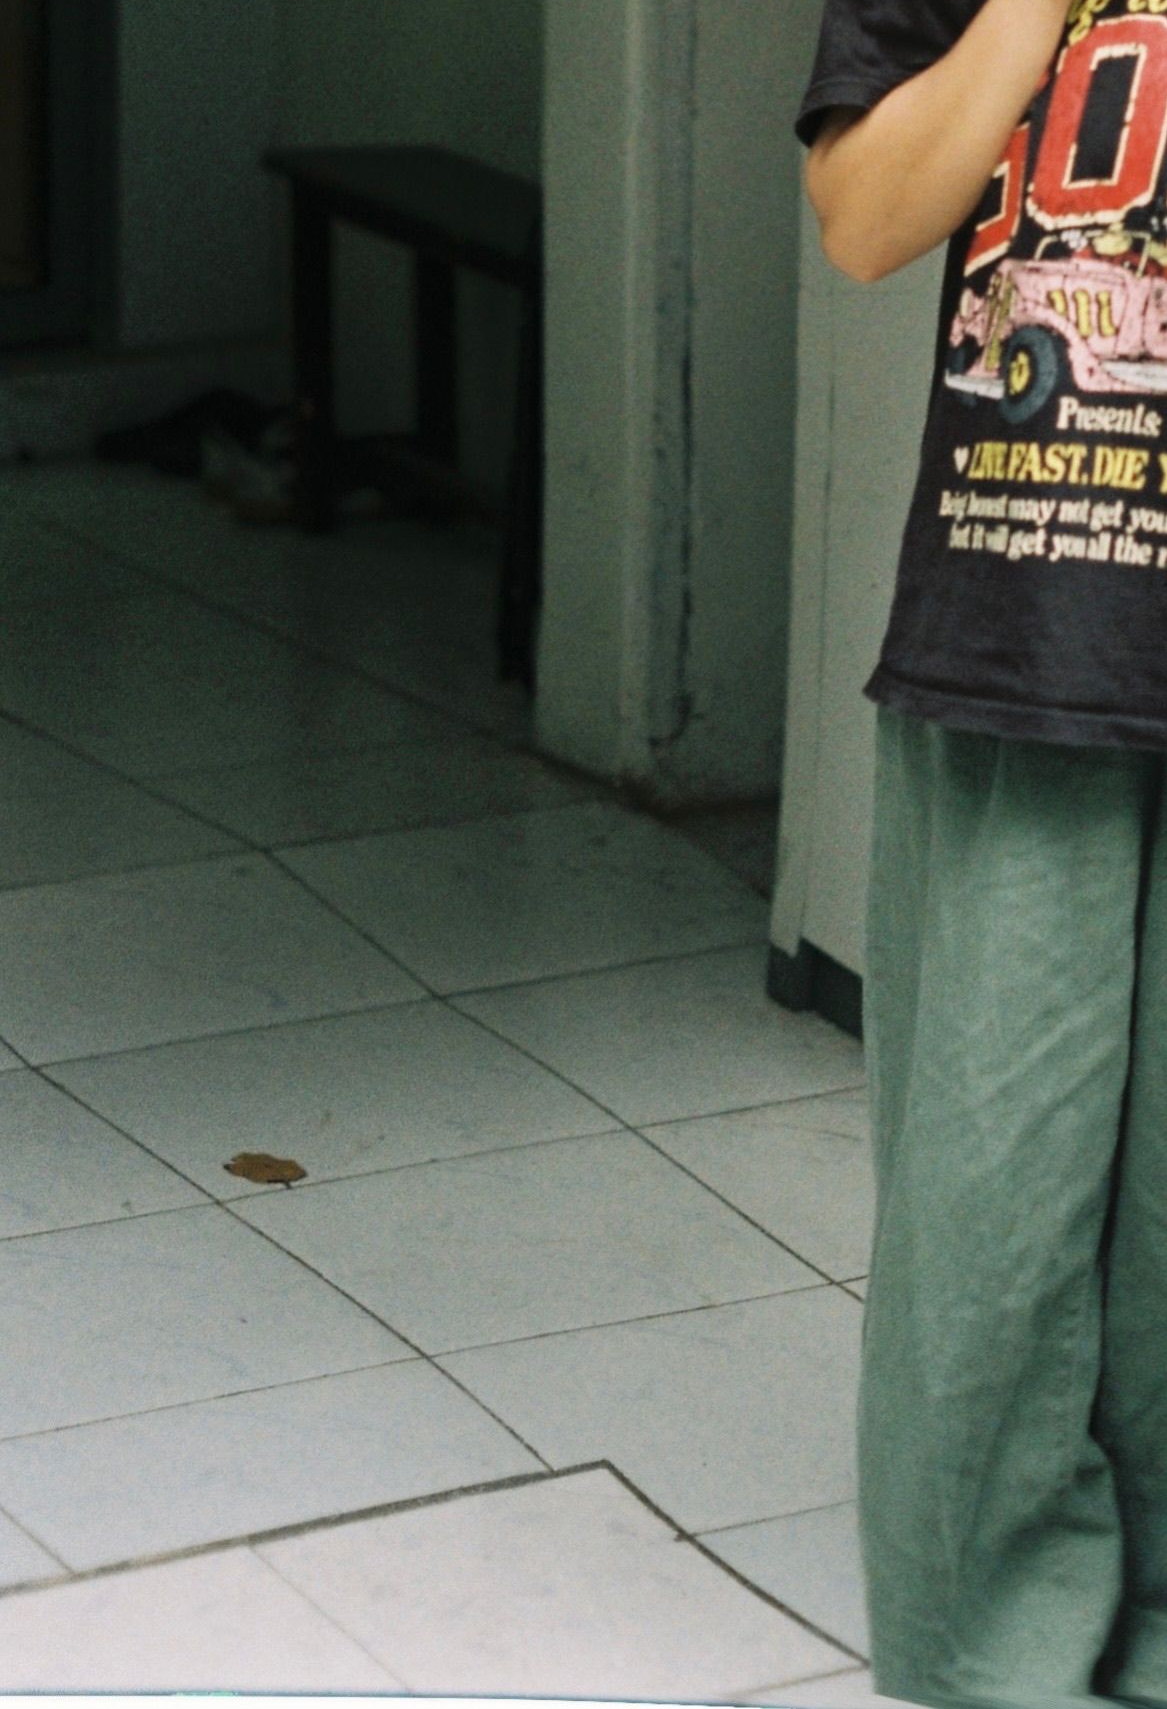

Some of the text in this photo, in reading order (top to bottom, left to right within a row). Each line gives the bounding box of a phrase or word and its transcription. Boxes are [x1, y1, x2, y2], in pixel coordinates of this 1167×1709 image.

[1092, 445, 1149, 490] DIE
[1008, 499, 1057, 526] may
[1058, 498, 1091, 524] not
[1089, 500, 1124, 532] get
[1007, 527, 1047, 561] get
[1114, 532, 1153, 565] the
